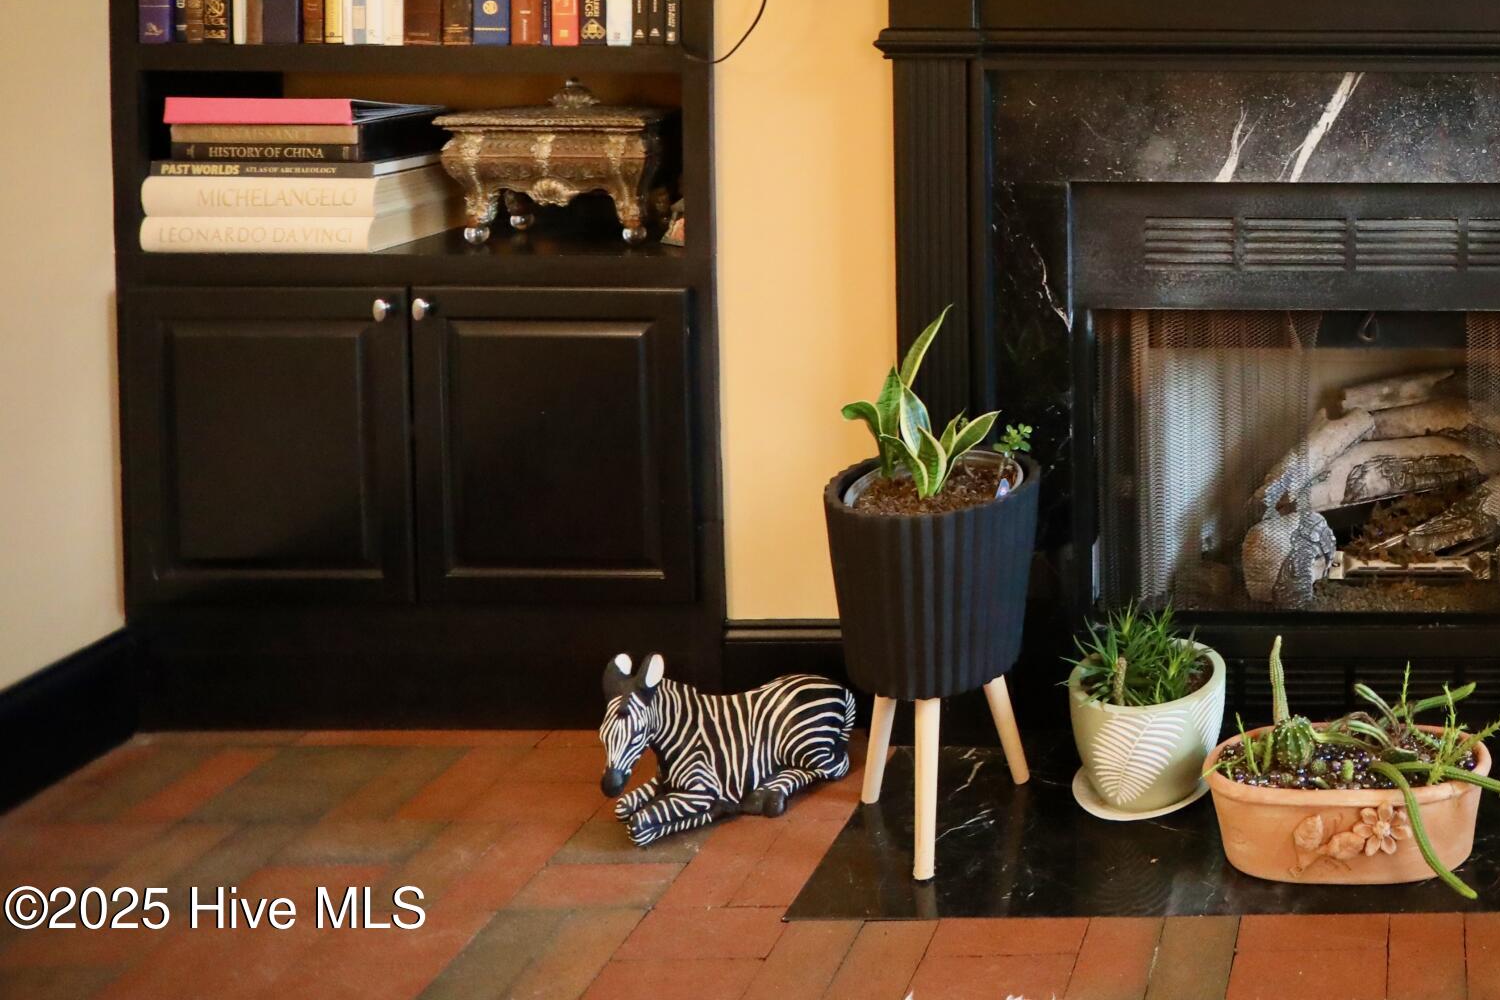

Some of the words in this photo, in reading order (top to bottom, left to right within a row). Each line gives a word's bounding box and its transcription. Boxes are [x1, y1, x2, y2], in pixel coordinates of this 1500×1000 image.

[208, 147, 264, 159] HISTORY
[265, 147, 282, 158] OF
[284, 147, 324, 159] CHINA
[160, 164, 190, 175] PAST
[191, 164, 240, 175] WORLDS
[198, 187, 357, 208] MICHELANGELO
[159, 226, 266, 244] LEONARDO
[273, 226, 297, 244] DA
[298, 226, 352, 244] VINCI
